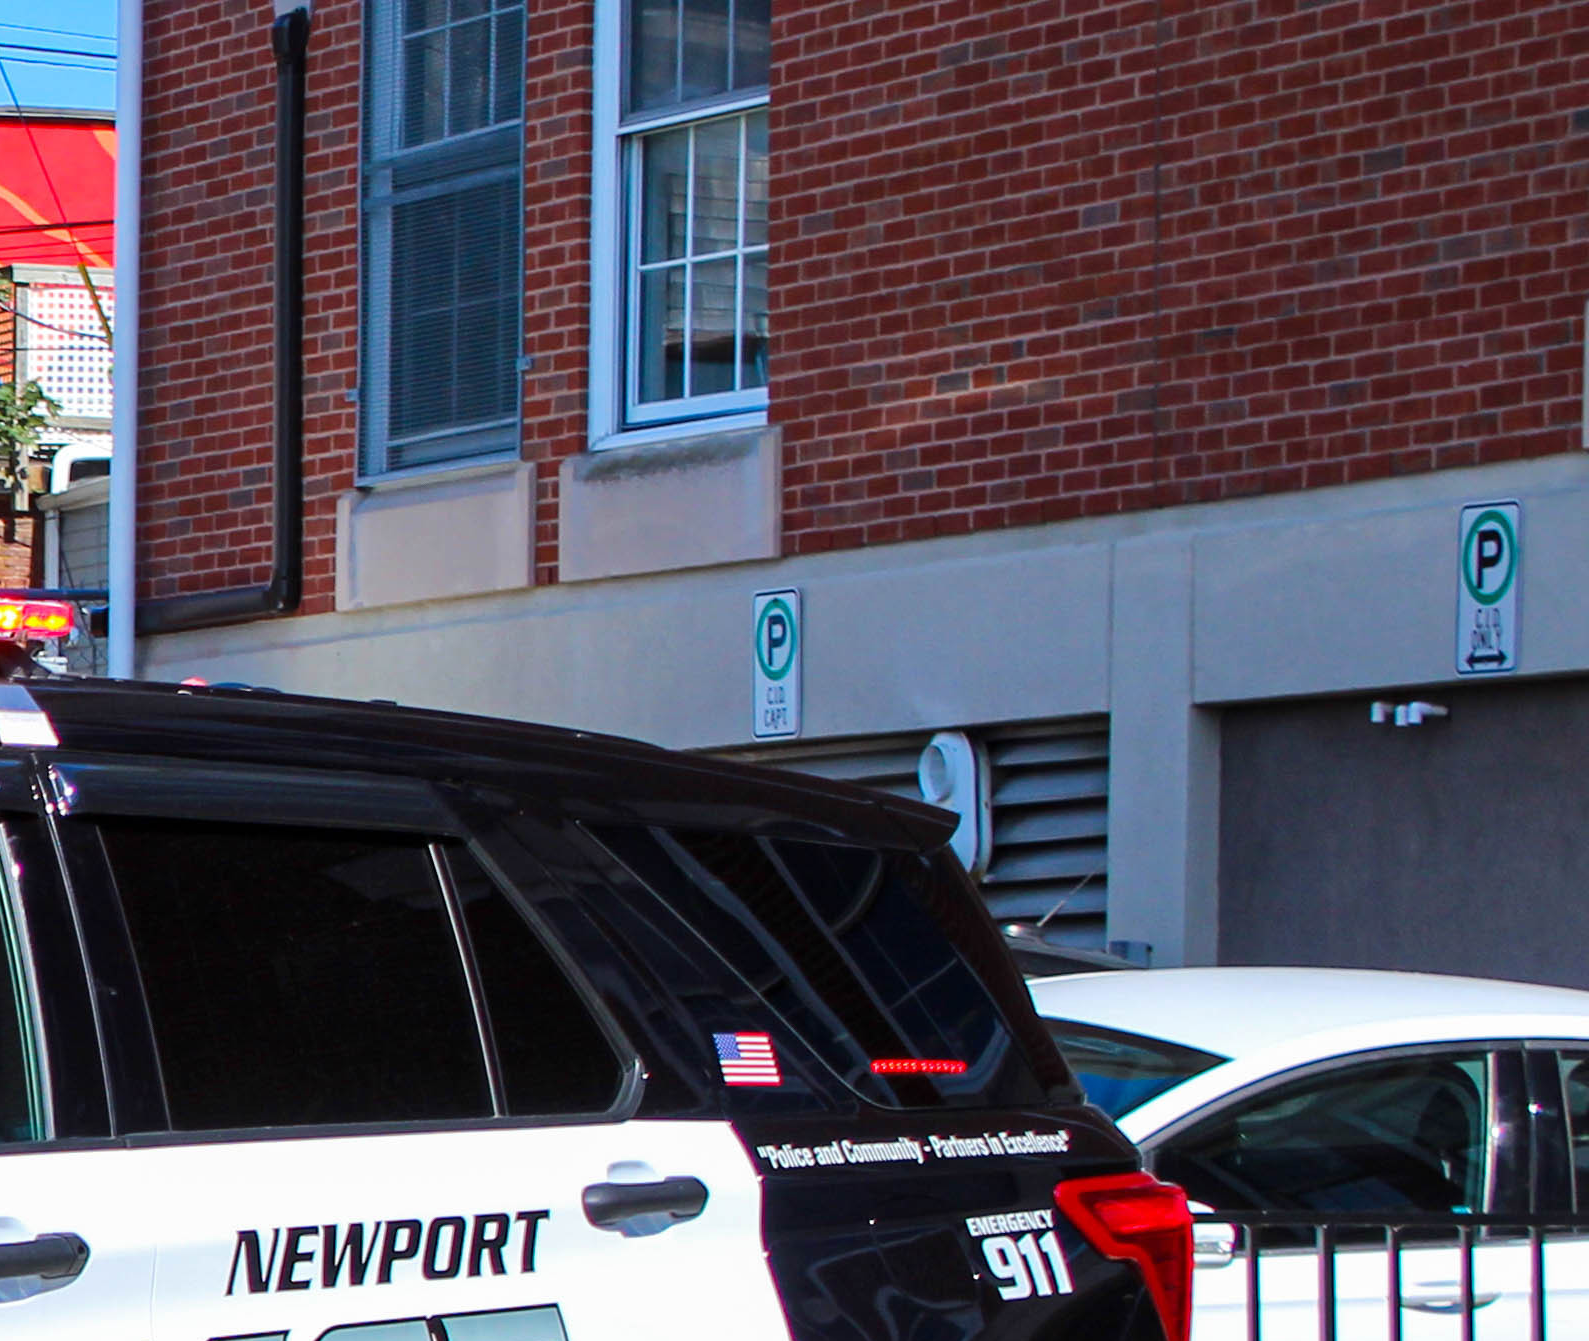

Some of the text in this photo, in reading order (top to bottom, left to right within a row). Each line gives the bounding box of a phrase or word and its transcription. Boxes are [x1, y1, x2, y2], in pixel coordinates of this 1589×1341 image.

[1477, 529, 1504, 589] P
[767, 613, 787, 667] P
[817, 1141, 846, 1166] and
[841, 1136, 925, 1164] Community
[927, 1135, 990, 1158] Partners
[983, 1133, 1003, 1155] in
[965, 1209, 1055, 1237] EMERGENCY
[225, 1209, 552, 1296] NEWPORT
[981, 1230, 1073, 1301] 911
